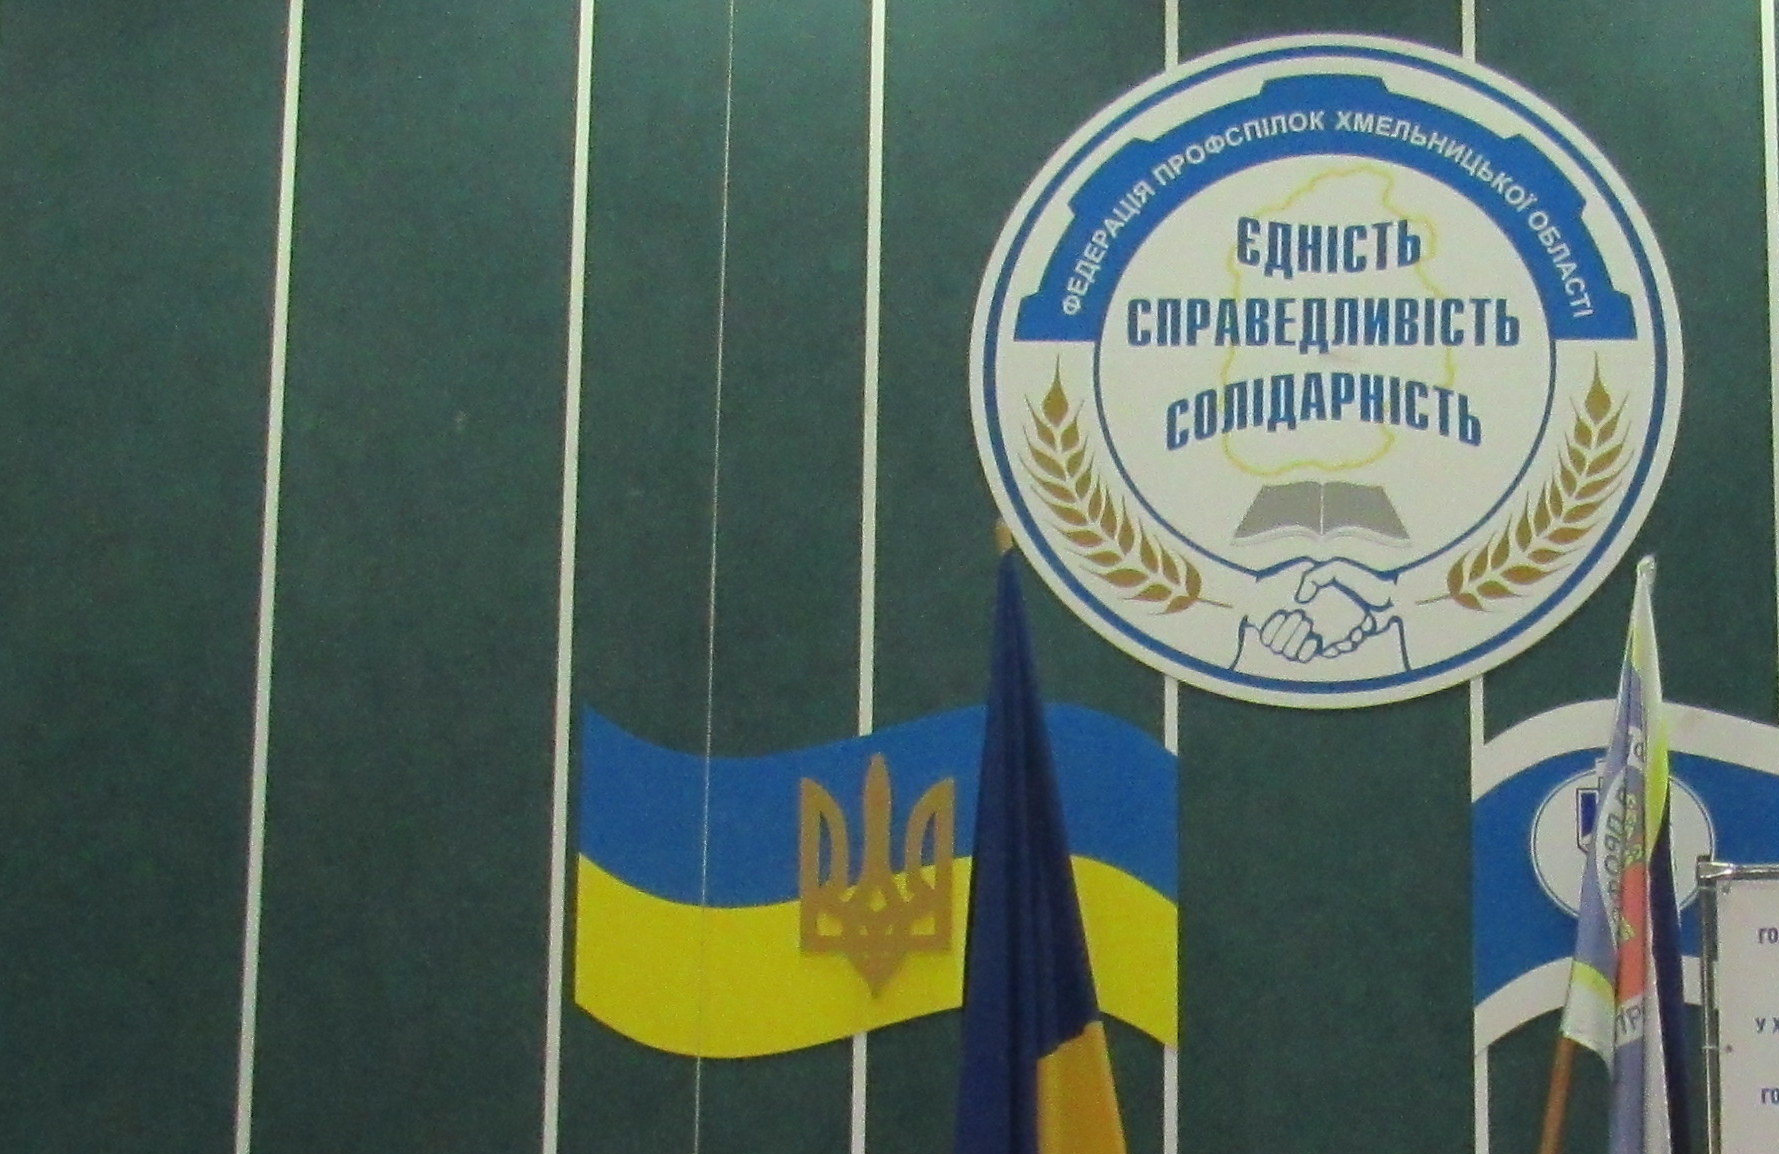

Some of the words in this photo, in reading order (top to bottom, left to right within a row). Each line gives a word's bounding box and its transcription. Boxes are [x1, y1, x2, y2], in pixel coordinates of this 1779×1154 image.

[1062, 180, 1156, 316] ФЕДЕРАЦІЯ
[1152, 110, 1325, 186] ПРОФСПІЛОК
[1335, 110, 1538, 213] ХМЕЛЬНИЦЬКОЇ
[1527, 210, 1594, 318] ОБЛАСТІ
[1237, 216, 1422, 279] ЄДНІСТЬ
[1127, 297, 1521, 354] СПРАВЕДЛИВІСТЬ
[1166, 372, 1482, 451] СОЛІДАРНІСТЬ
[1754, 1018, 1766, 1034] У
